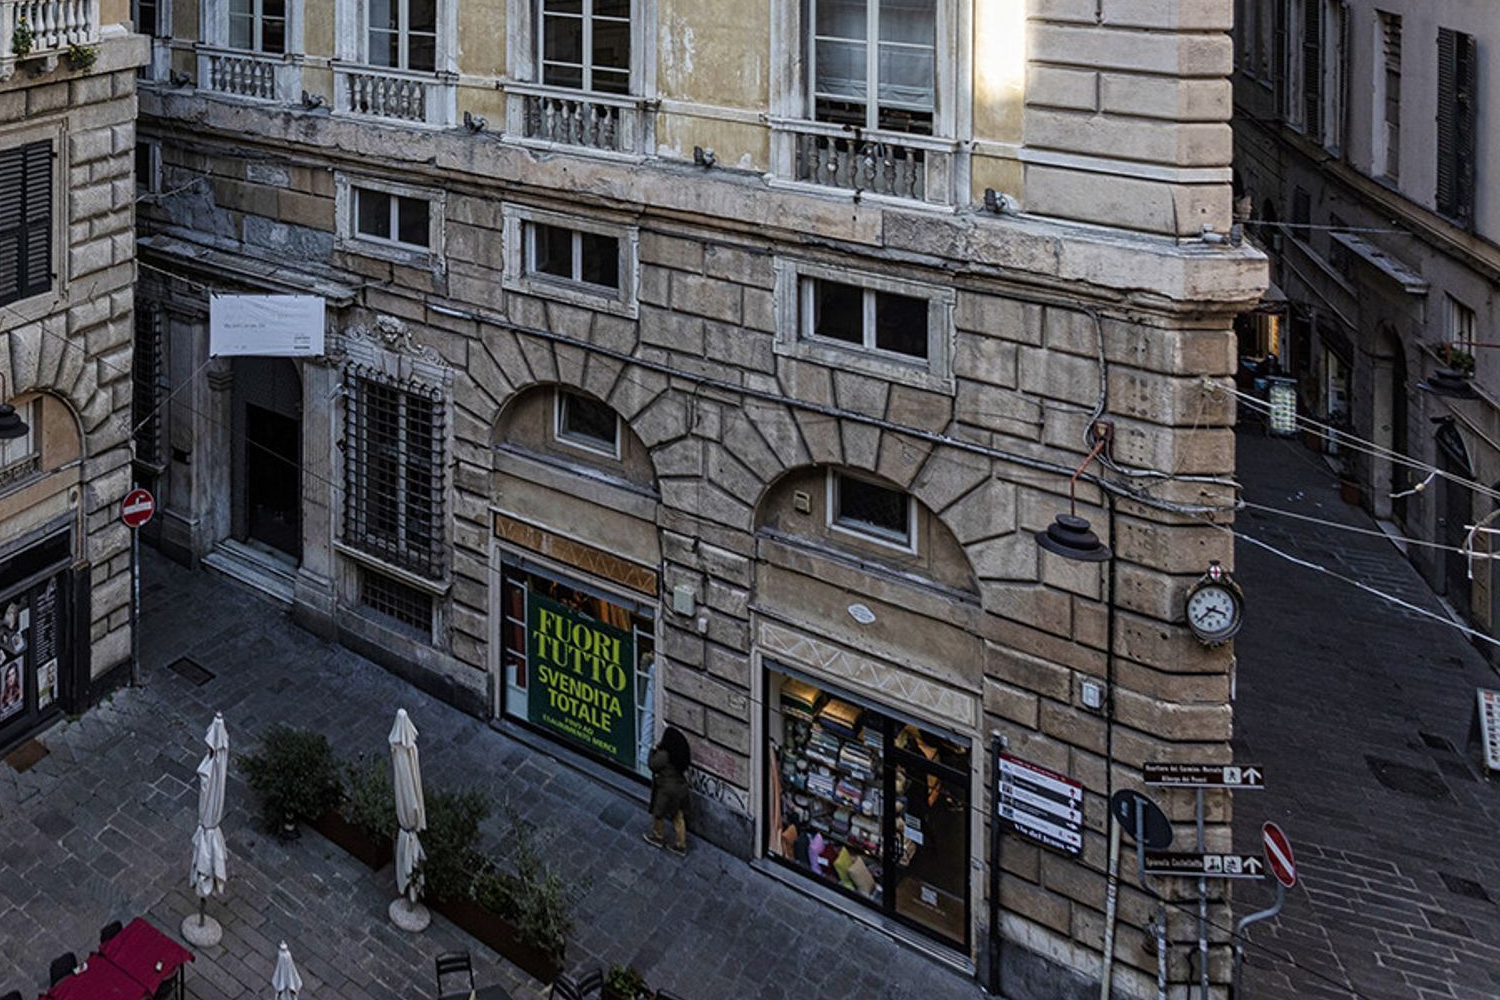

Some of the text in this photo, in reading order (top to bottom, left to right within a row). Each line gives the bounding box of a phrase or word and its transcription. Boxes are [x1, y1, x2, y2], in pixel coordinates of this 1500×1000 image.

[533, 630, 627, 692] TUTTO
[539, 607, 621, 665] FUORI
[538, 664, 623, 718] SVENDITA
[548, 687, 612, 733] TOTALE
